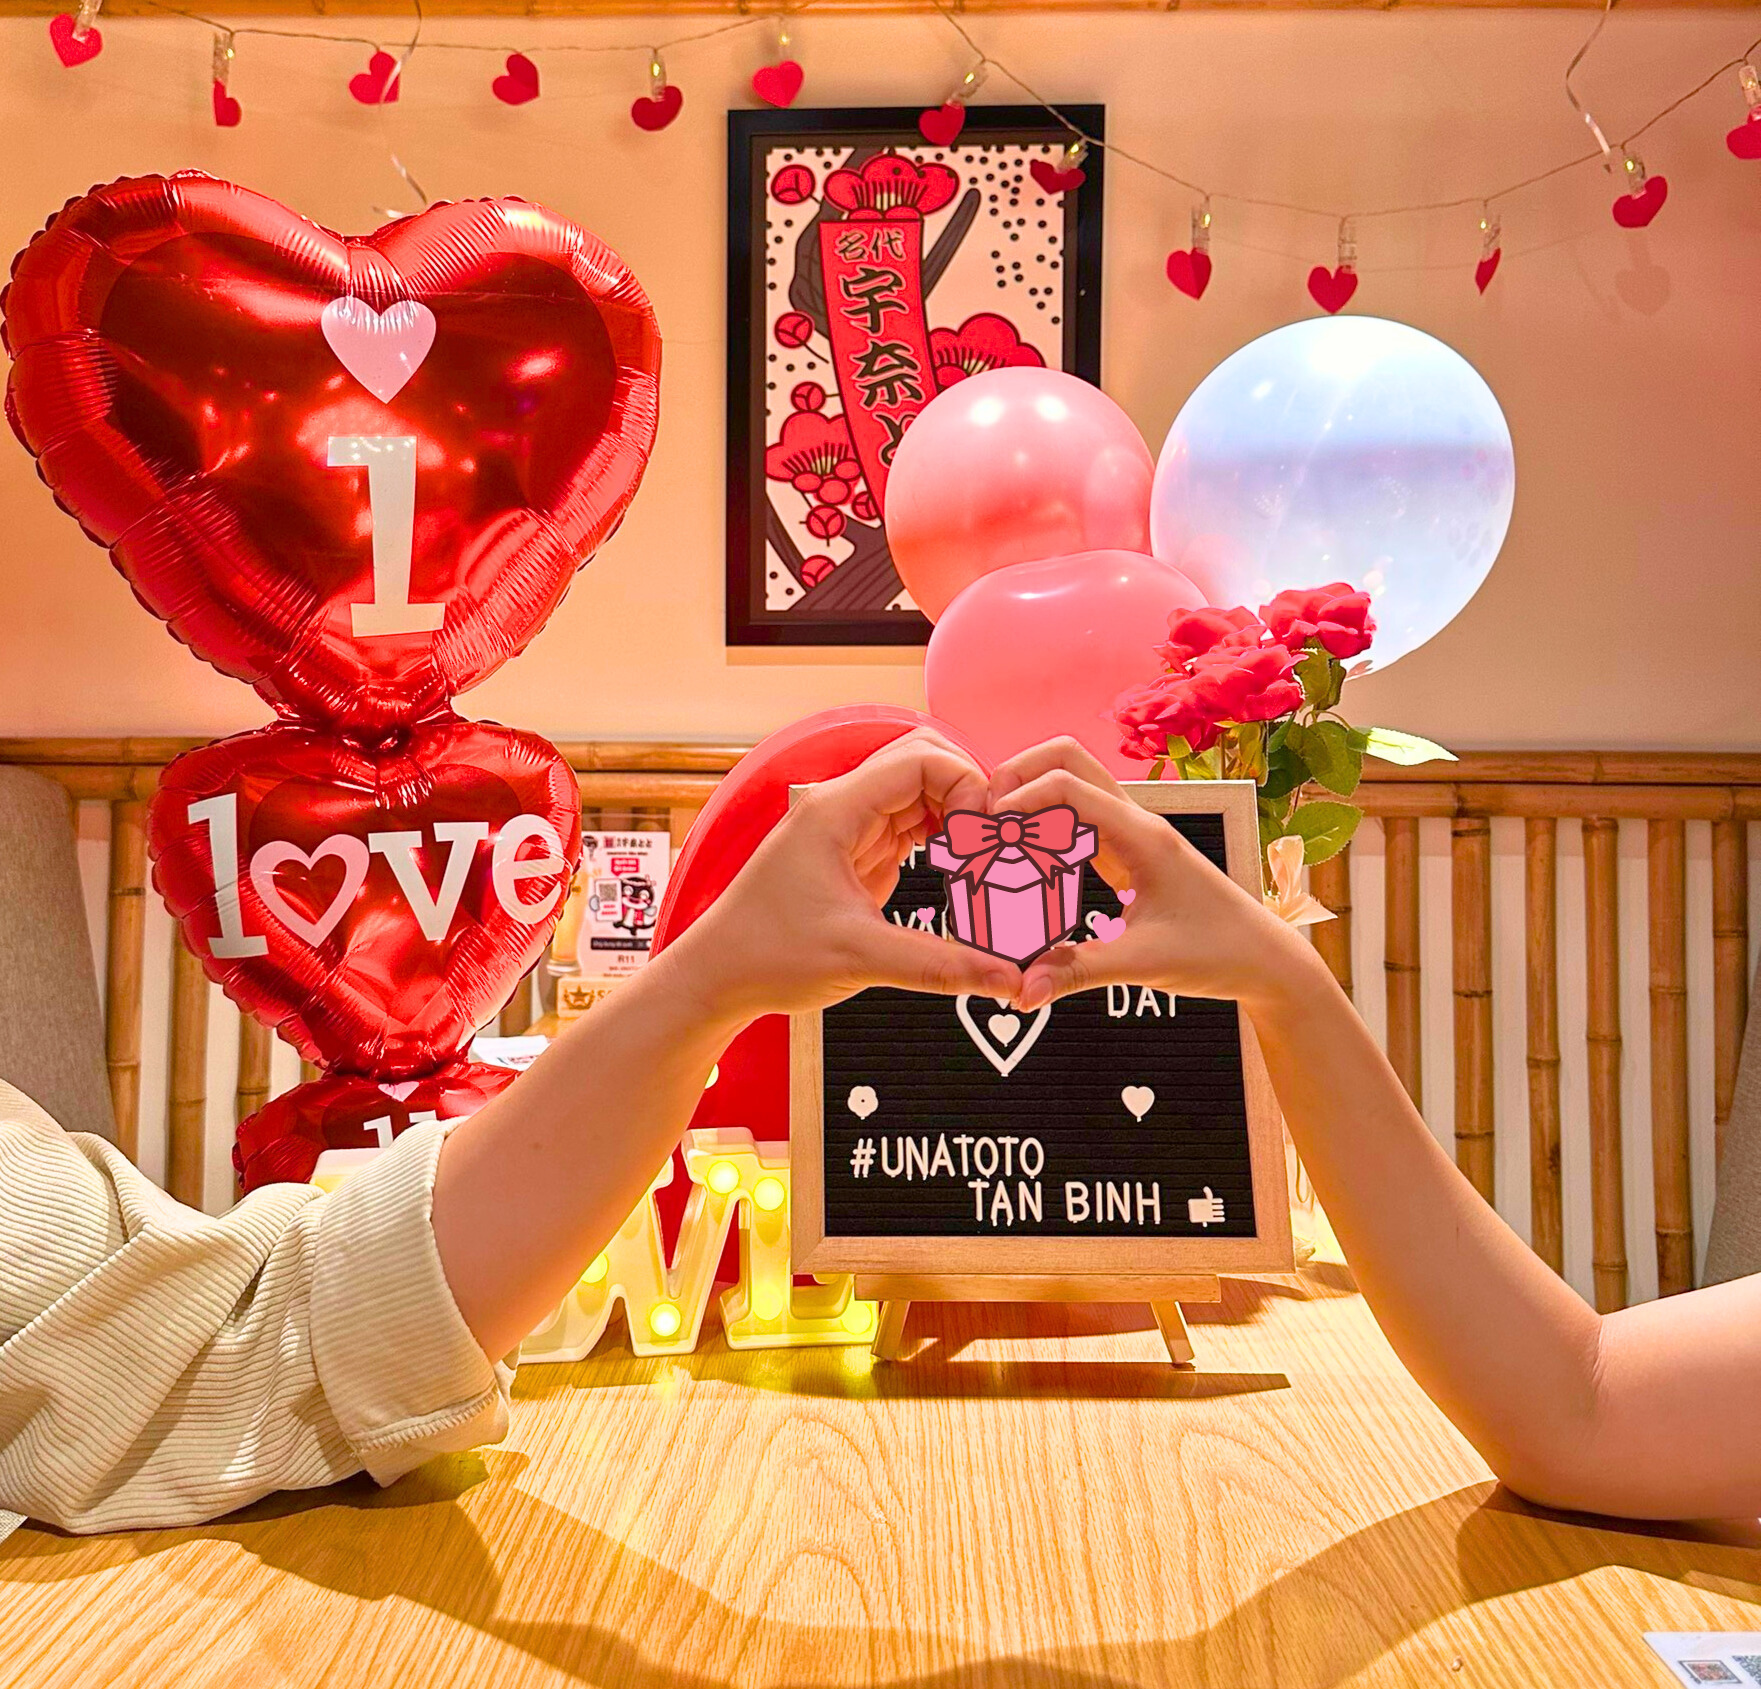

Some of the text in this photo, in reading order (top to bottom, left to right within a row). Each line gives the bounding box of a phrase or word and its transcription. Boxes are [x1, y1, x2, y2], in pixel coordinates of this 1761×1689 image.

[835, 228, 905, 262] 名代
[850, 1134, 1044, 1181] #UNATOTO
[968, 1178, 1161, 1226] TAN BINH
